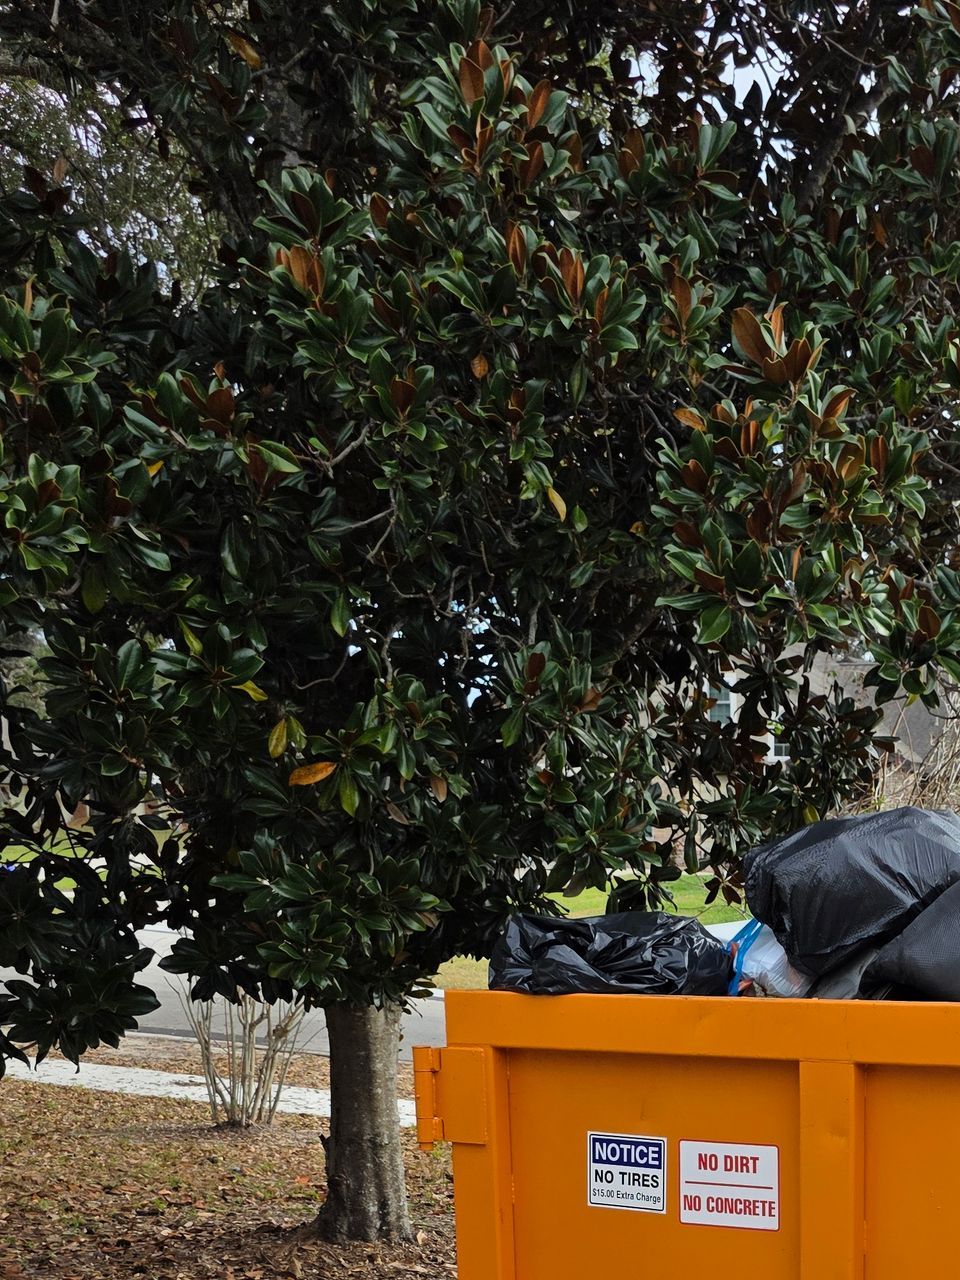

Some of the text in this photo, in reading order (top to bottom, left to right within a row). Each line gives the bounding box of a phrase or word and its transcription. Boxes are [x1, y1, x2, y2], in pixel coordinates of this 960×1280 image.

[595, 1142, 659, 1165] NOTICE
[698, 1153, 759, 1174] NO DIRT
[594, 1169, 659, 1189] NO TIRES
[592, 1188, 661, 1205] $15.00 Extra Charge
[683, 1194, 776, 1218] NO CONCRETE
